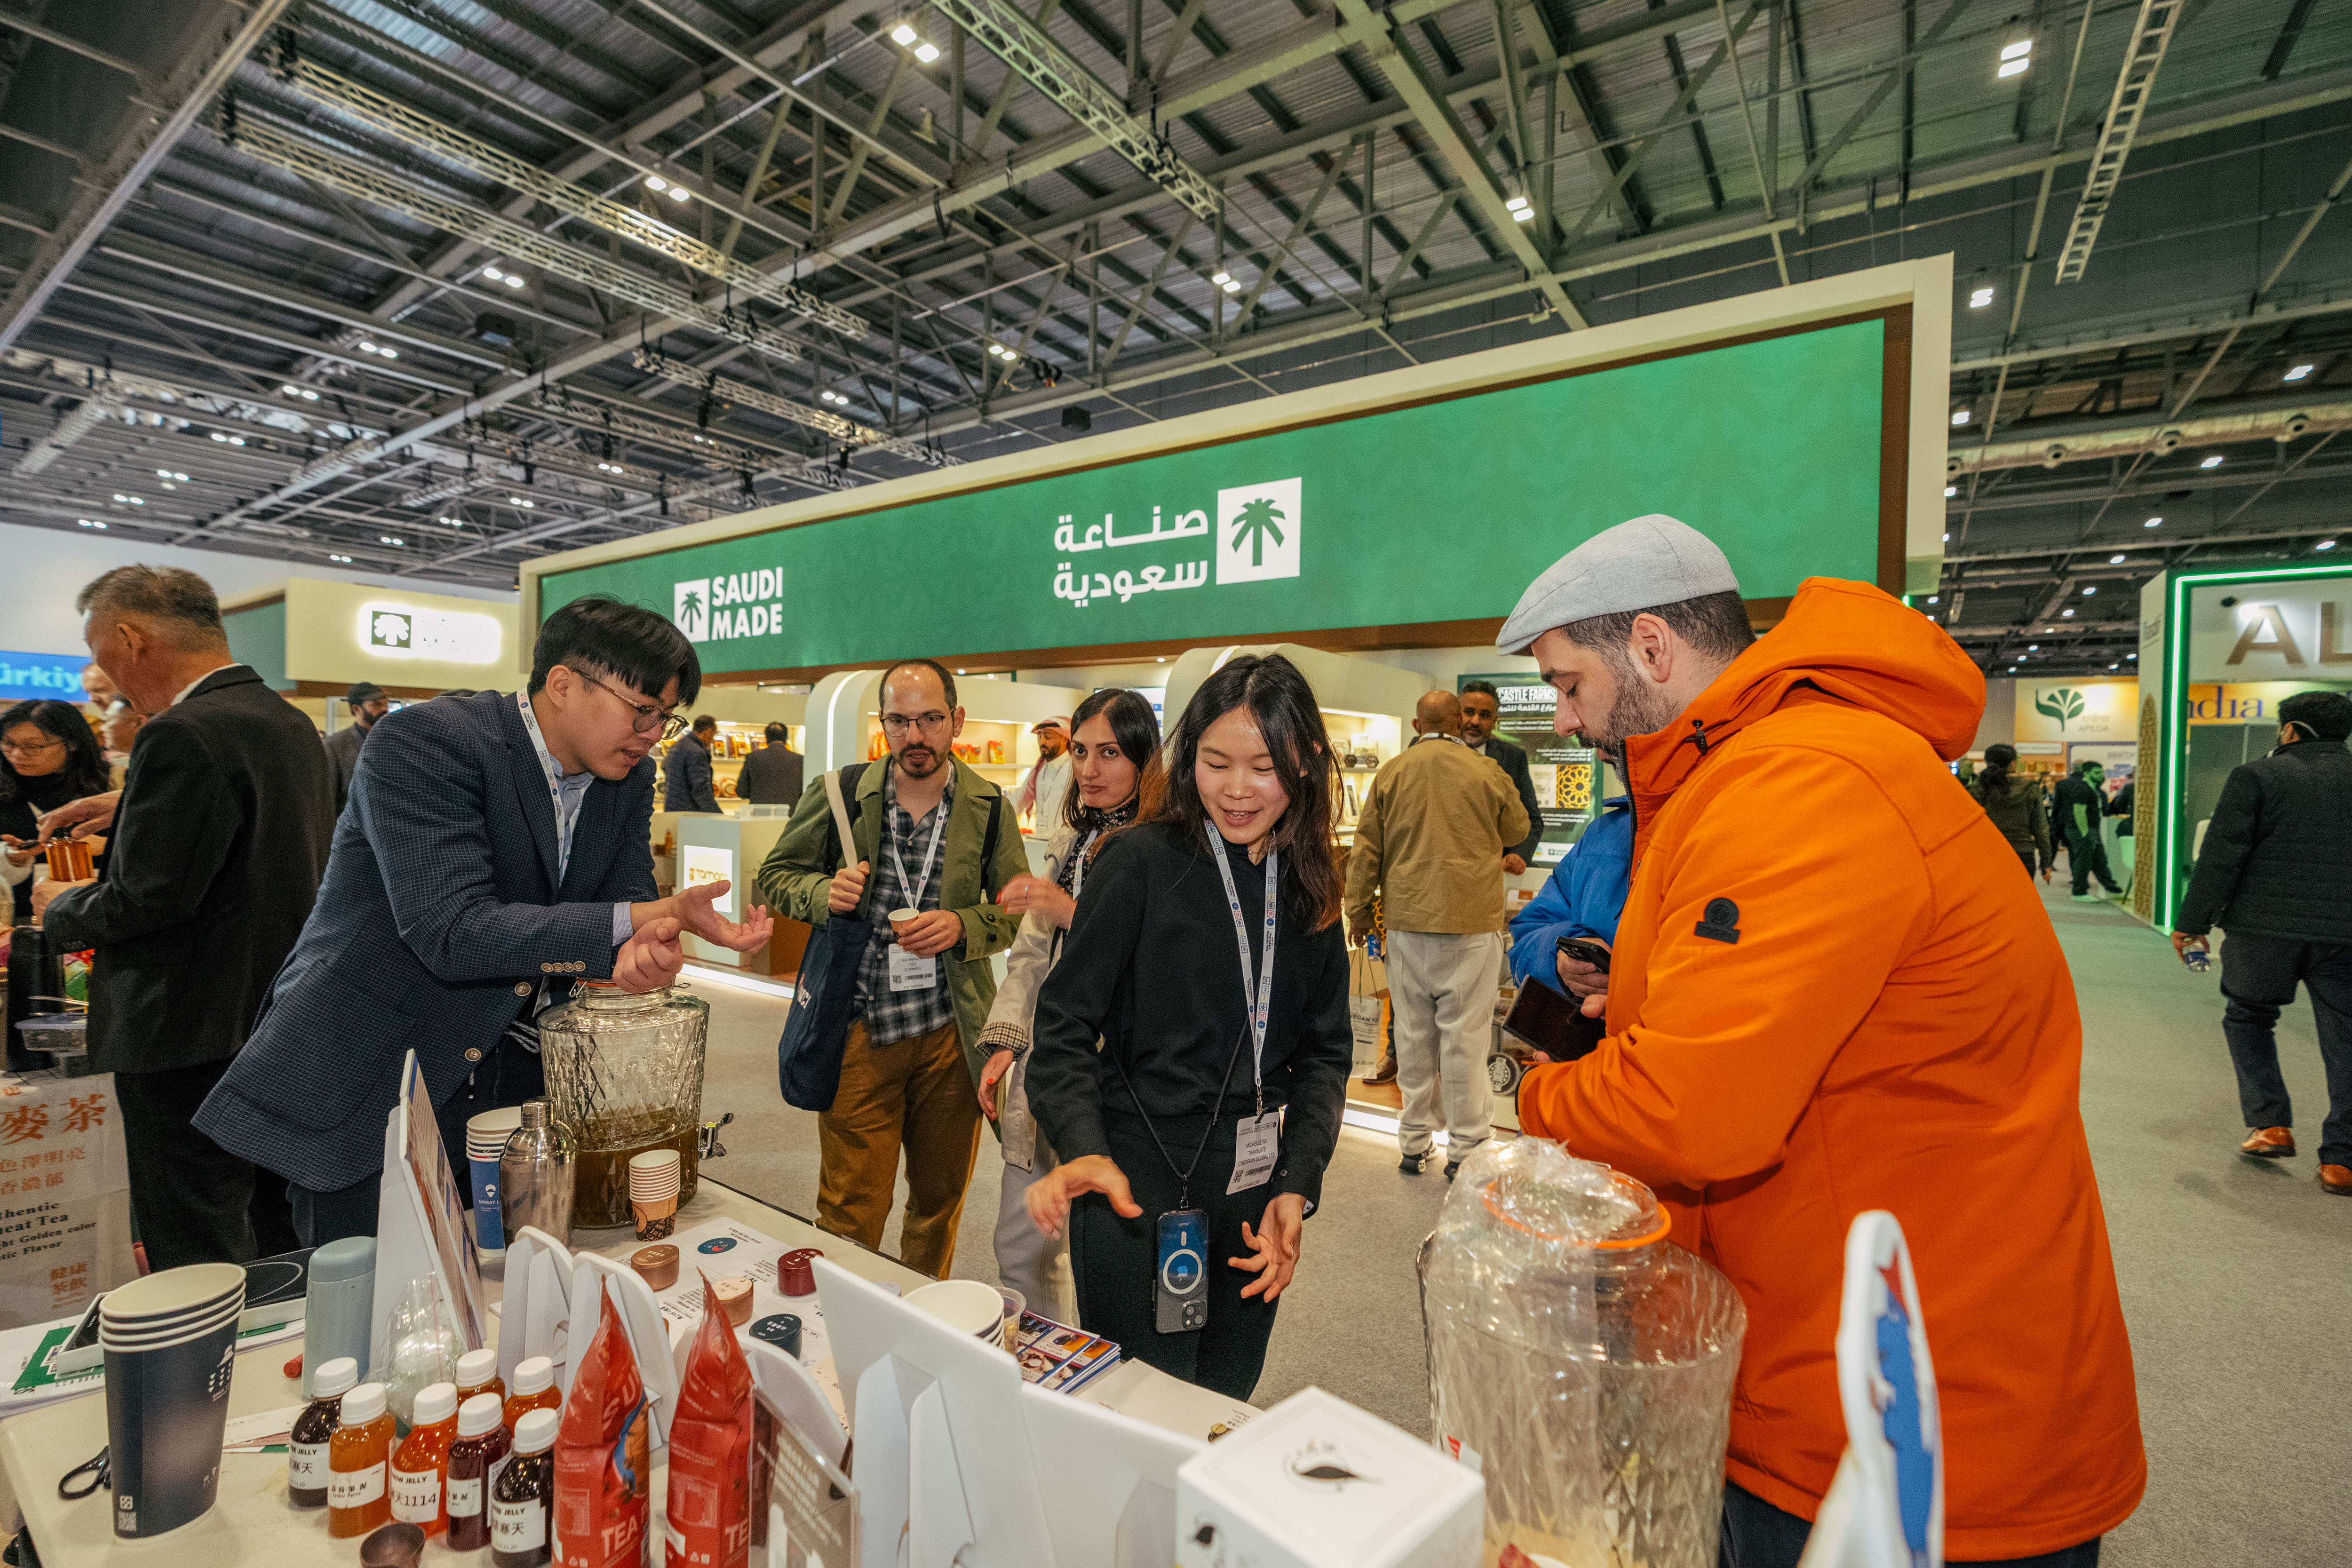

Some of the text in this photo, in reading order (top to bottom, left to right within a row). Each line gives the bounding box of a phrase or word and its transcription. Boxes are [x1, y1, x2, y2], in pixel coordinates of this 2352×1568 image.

[1054, 505, 1209, 553] صناعة
[712, 567, 783, 607] SAUDI
[1053, 560, 1208, 608] سعودية
[711, 603, 783, 641] MADE
[1499, 688, 1557, 701] CASTLE FARMS
[1351, 1013, 1370, 1022] VEGAN
[0, 1093, 107, 1146] 麥茶
[1246, 1140, 1262, 1148] MICHELLE
[1248, 1146, 1266, 1156] TRANSLATE
[1238, 1157, 1255, 1166] CHERRAIN
[1242, 1180, 1260, 1189] EXHIBITOR
[36, 1214, 69, 1226] Tea
[20, 1229, 63, 1243] Golden
[67, 1222, 98, 1234] color
[23, 1242, 62, 1255] Flavor
[1045, 1344, 1064, 1353] INFUSER
[504, 1507, 526, 1516] JELLY
[601, 1519, 639, 1560] TEA
